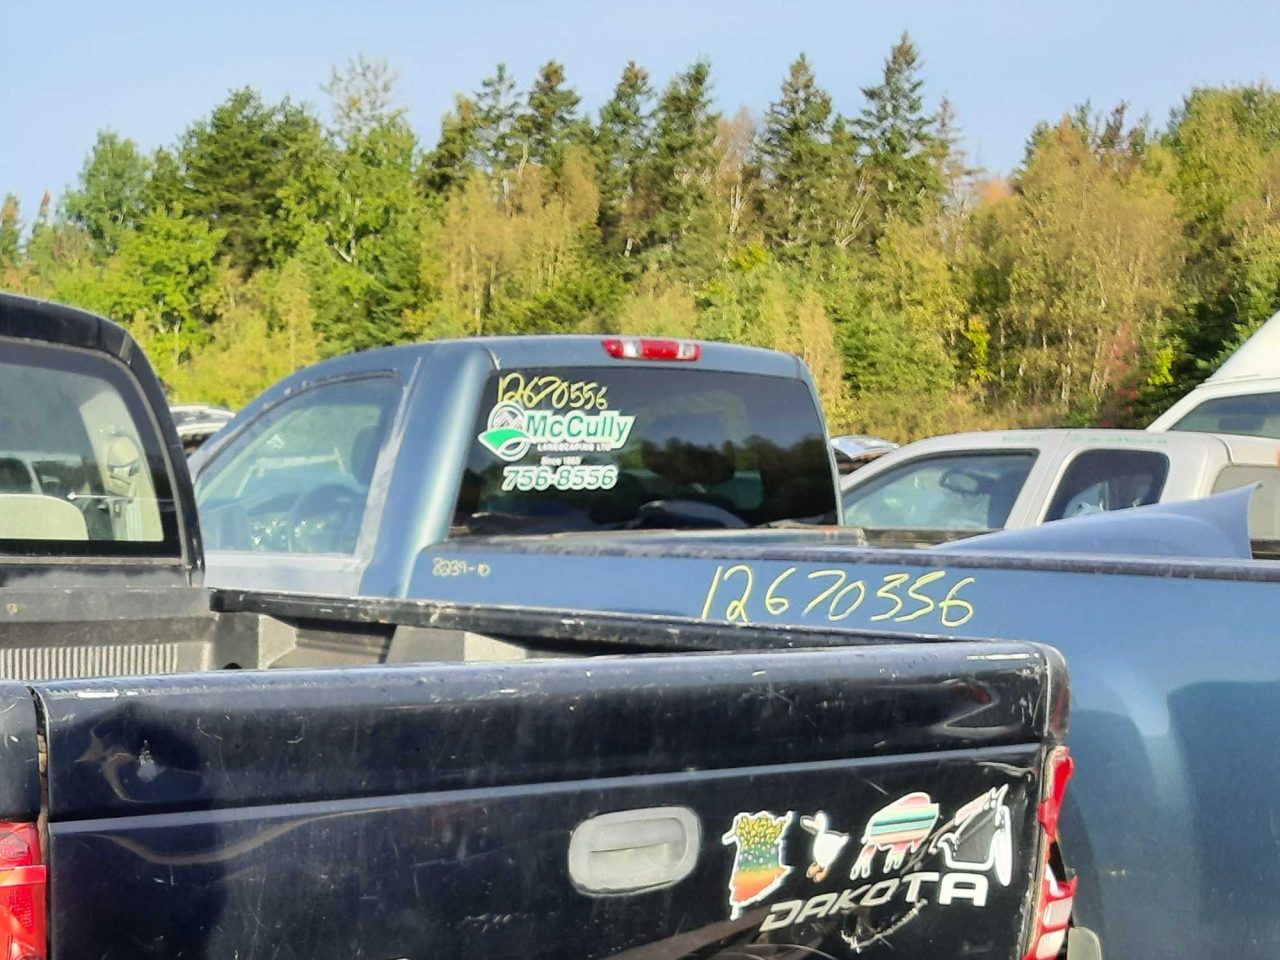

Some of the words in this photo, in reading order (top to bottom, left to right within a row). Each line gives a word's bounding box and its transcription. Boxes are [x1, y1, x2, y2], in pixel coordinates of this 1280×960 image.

[525, 413, 631, 444] McCully
[503, 466, 617, 490] 756-8556
[759, 871, 989, 932] DAKOTA
